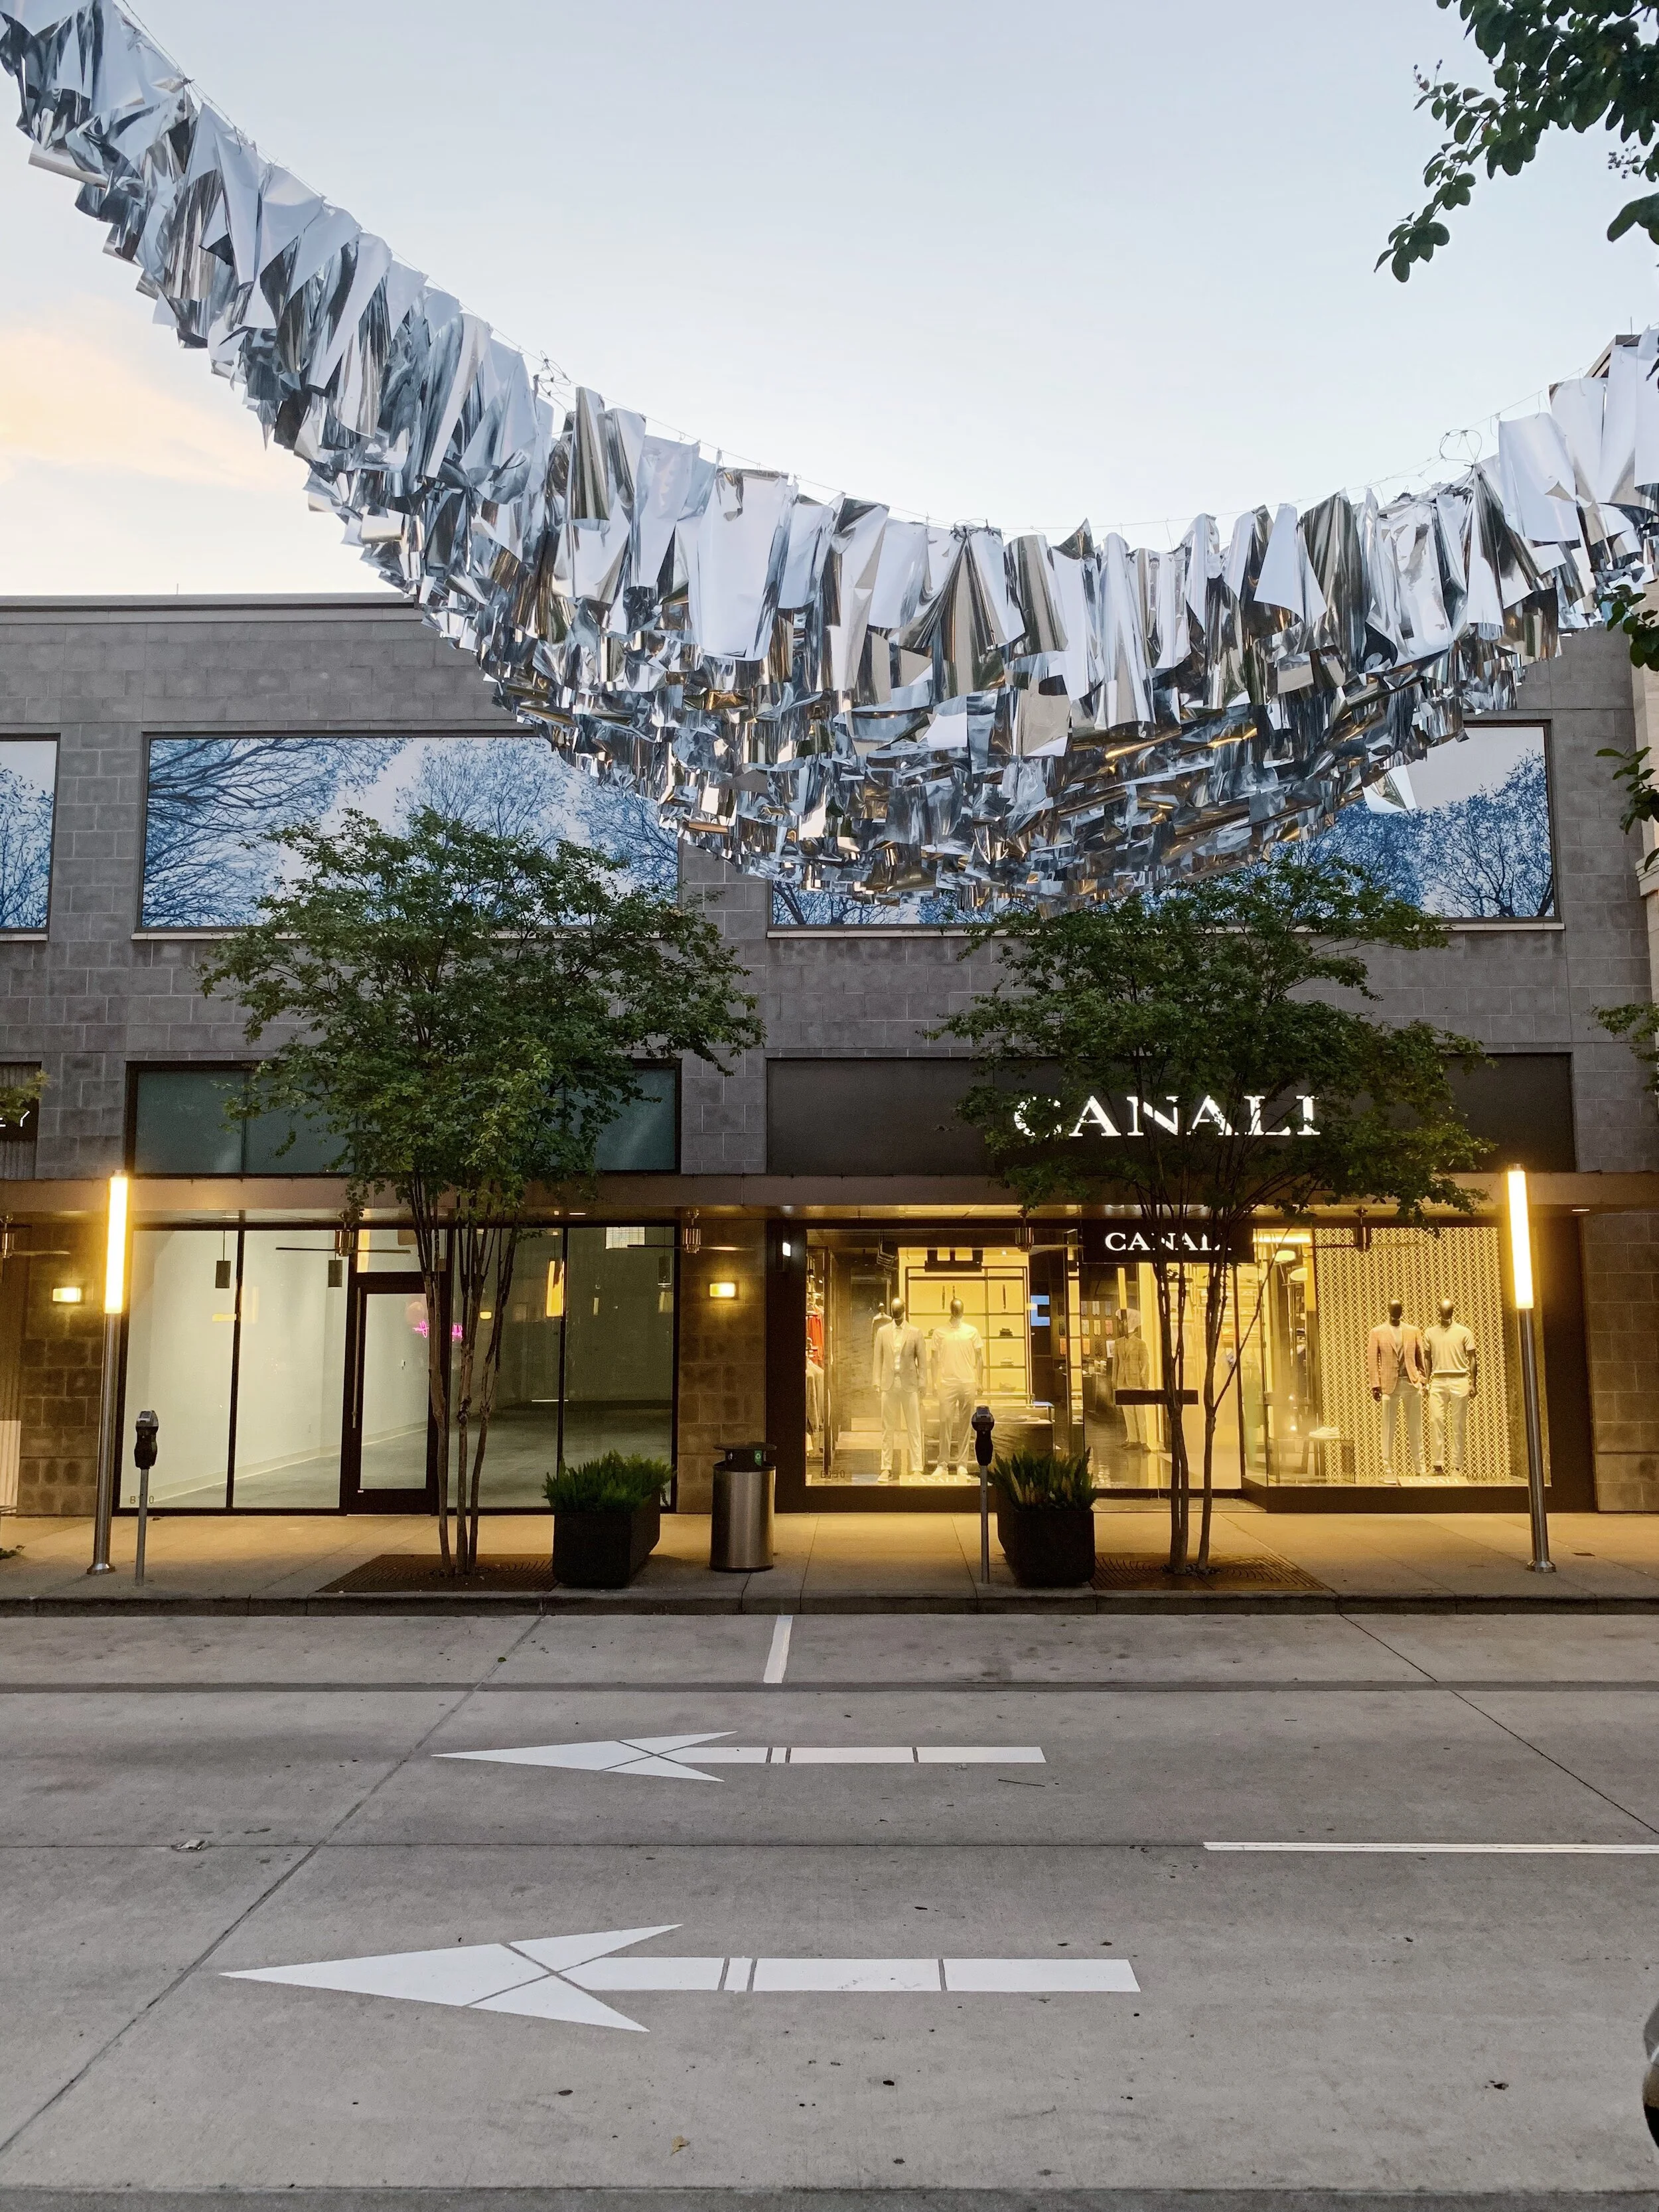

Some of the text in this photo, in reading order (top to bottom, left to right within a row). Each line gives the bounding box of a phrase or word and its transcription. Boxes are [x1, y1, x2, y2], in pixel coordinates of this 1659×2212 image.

[1014, 1095, 1321, 1137] CANALI
[1105, 1232, 1232, 1251] CANAL
[129, 1495, 155, 1505] B0
